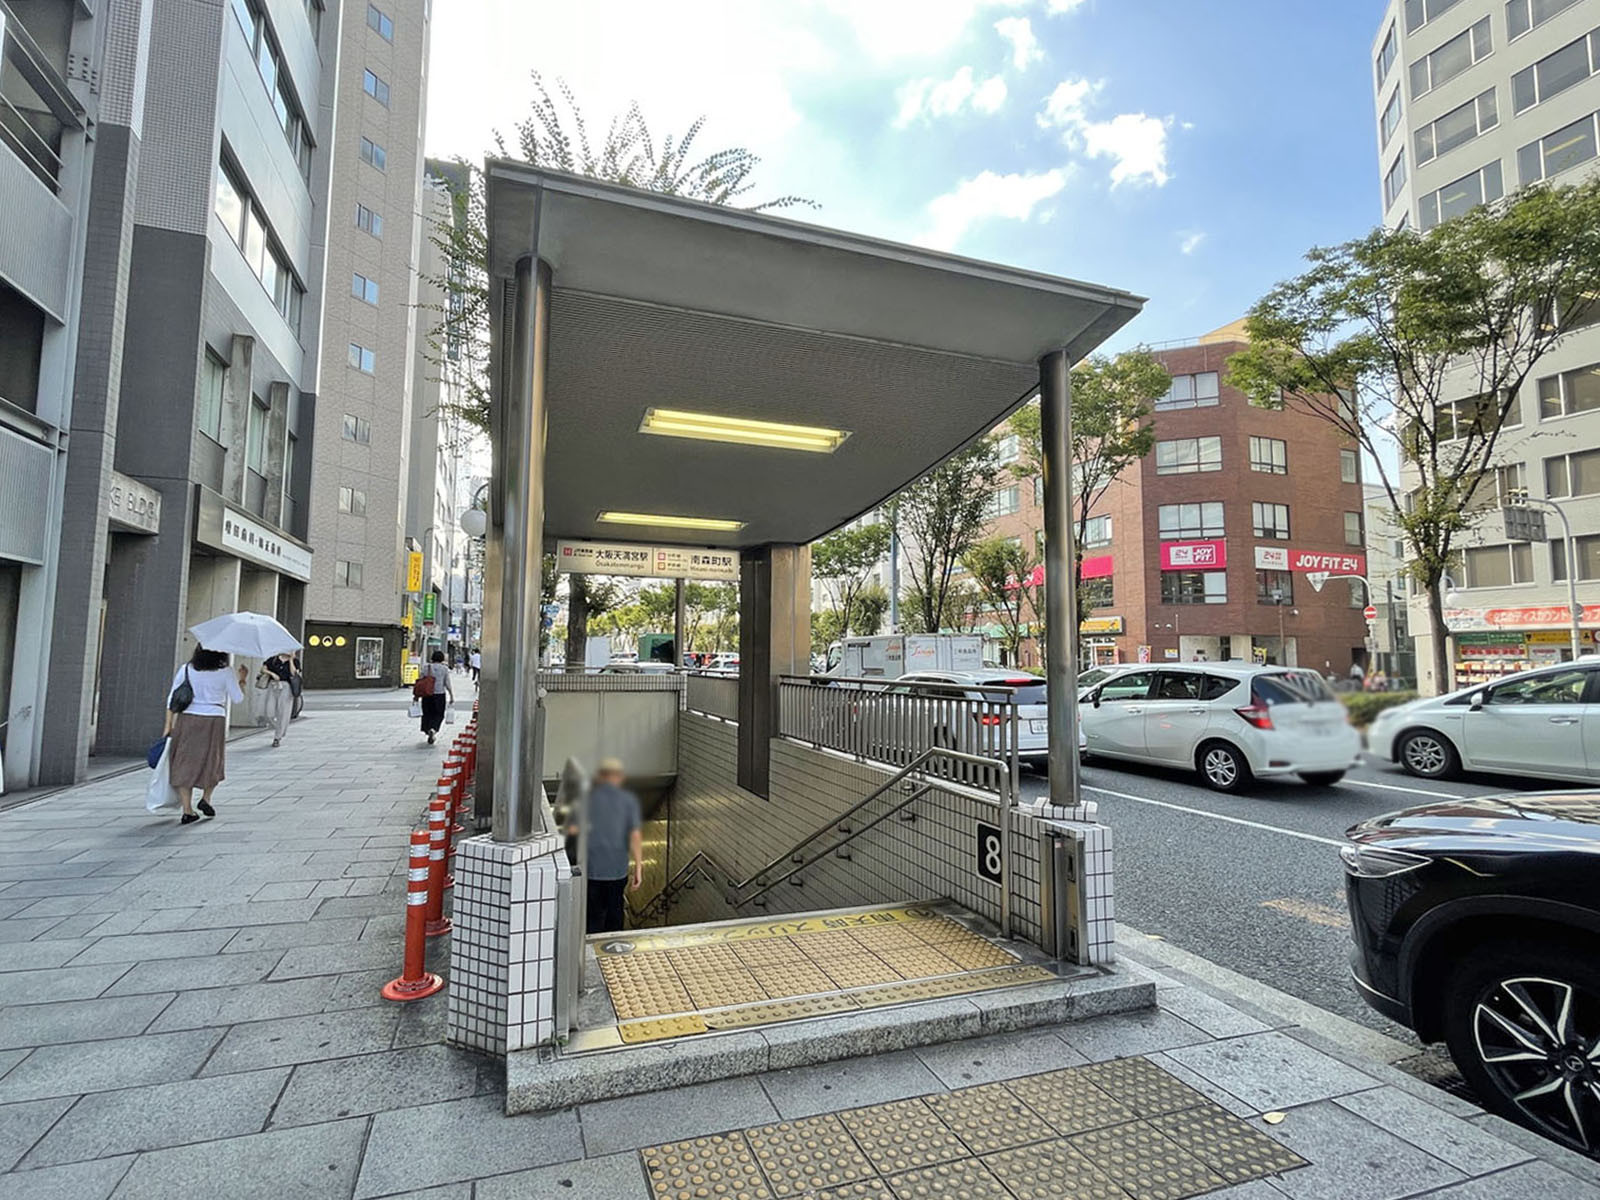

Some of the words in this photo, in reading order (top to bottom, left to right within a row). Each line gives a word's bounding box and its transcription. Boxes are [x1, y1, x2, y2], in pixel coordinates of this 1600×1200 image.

[128, 492, 155, 519] BLDG
[595, 550, 648, 561] 大阪天満宮駅
[691, 554, 732, 566] 南森町駅
[1296, 555, 1321, 568] JOY
[1321, 556, 1339, 570] FIT
[1342, 558, 1358, 571] 24
[985, 835, 1001, 875] 8
[821, 910, 898, 930] 雨天時
